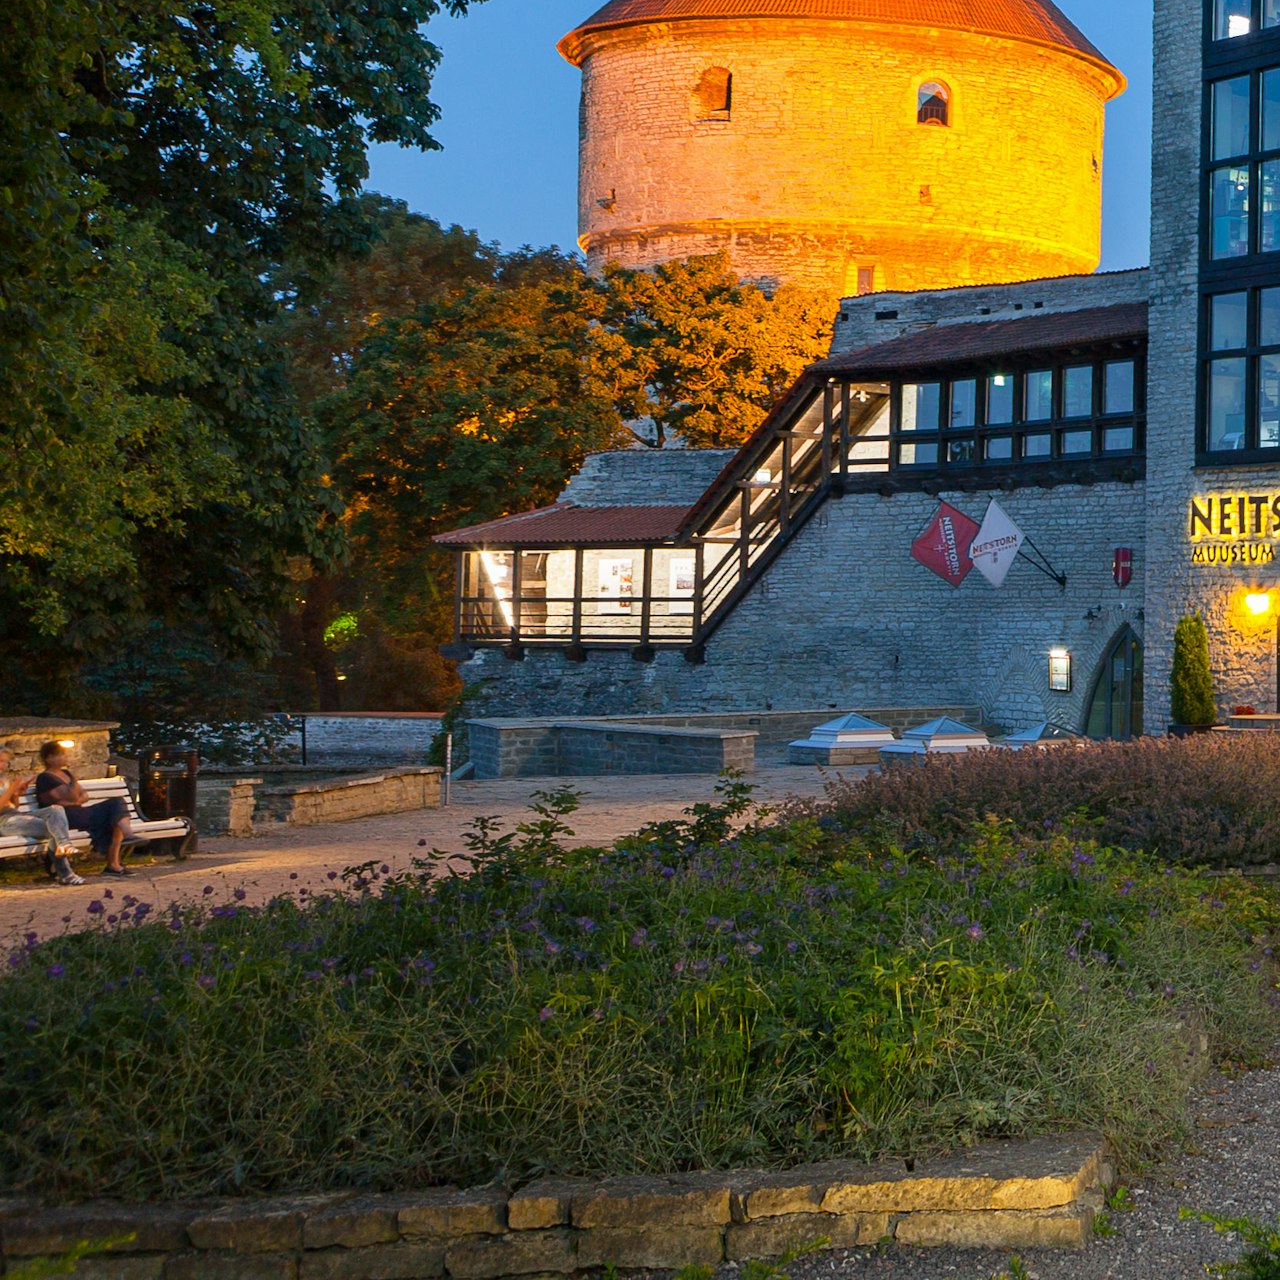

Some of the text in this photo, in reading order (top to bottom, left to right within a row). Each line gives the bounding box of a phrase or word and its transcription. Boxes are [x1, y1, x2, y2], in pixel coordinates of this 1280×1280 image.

[943, 516, 960, 576] NEITSITORN
[972, 534, 1017, 554] NEITSTORN
[1192, 543, 1277, 563] MUUSEUM
